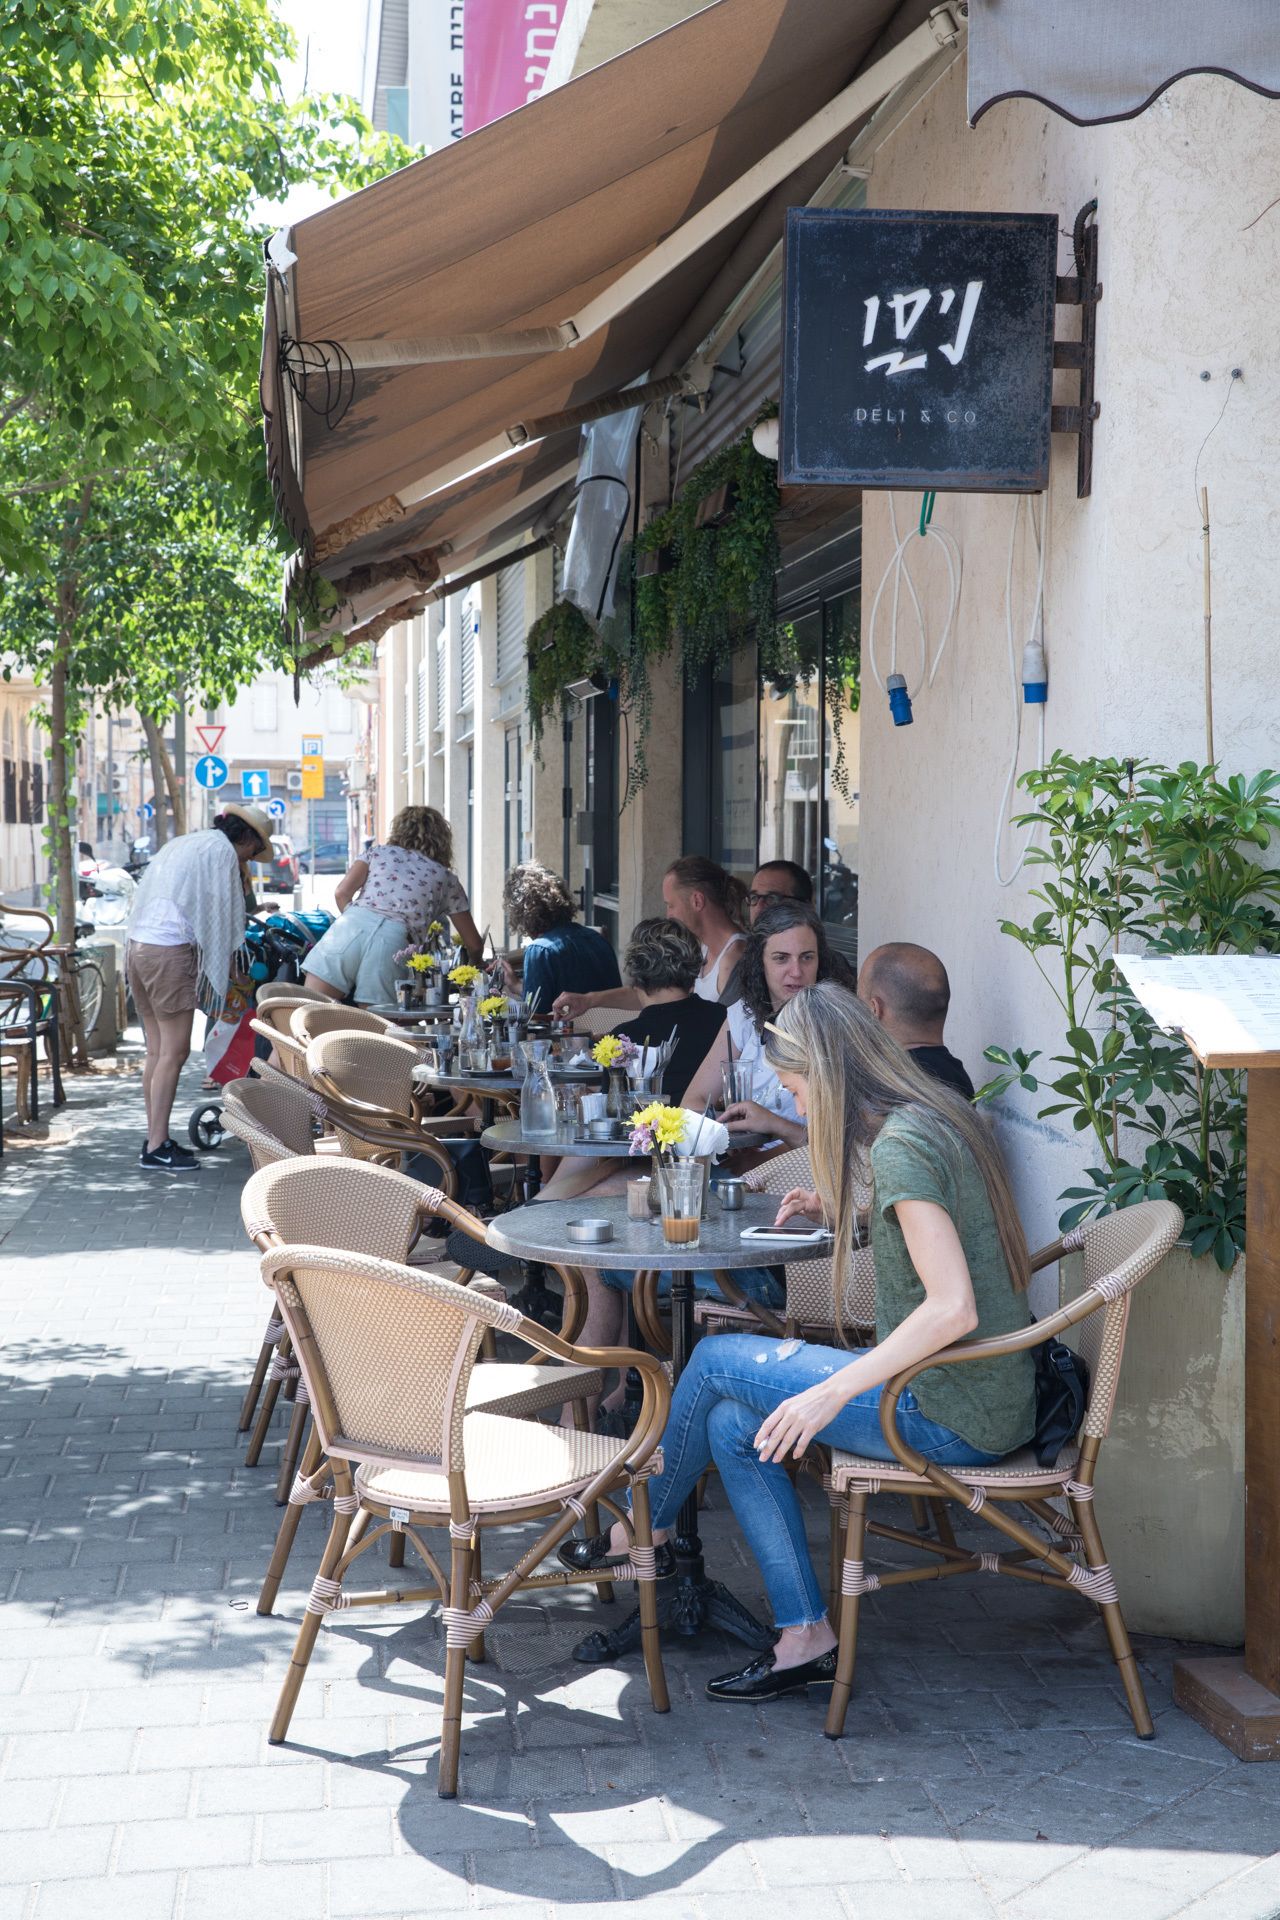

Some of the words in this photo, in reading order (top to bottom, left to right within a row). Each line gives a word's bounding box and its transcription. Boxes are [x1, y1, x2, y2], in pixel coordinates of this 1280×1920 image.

[856, 408, 905, 422] DELI
[921, 410, 931, 423] &
[947, 410, 976, 423] CO
